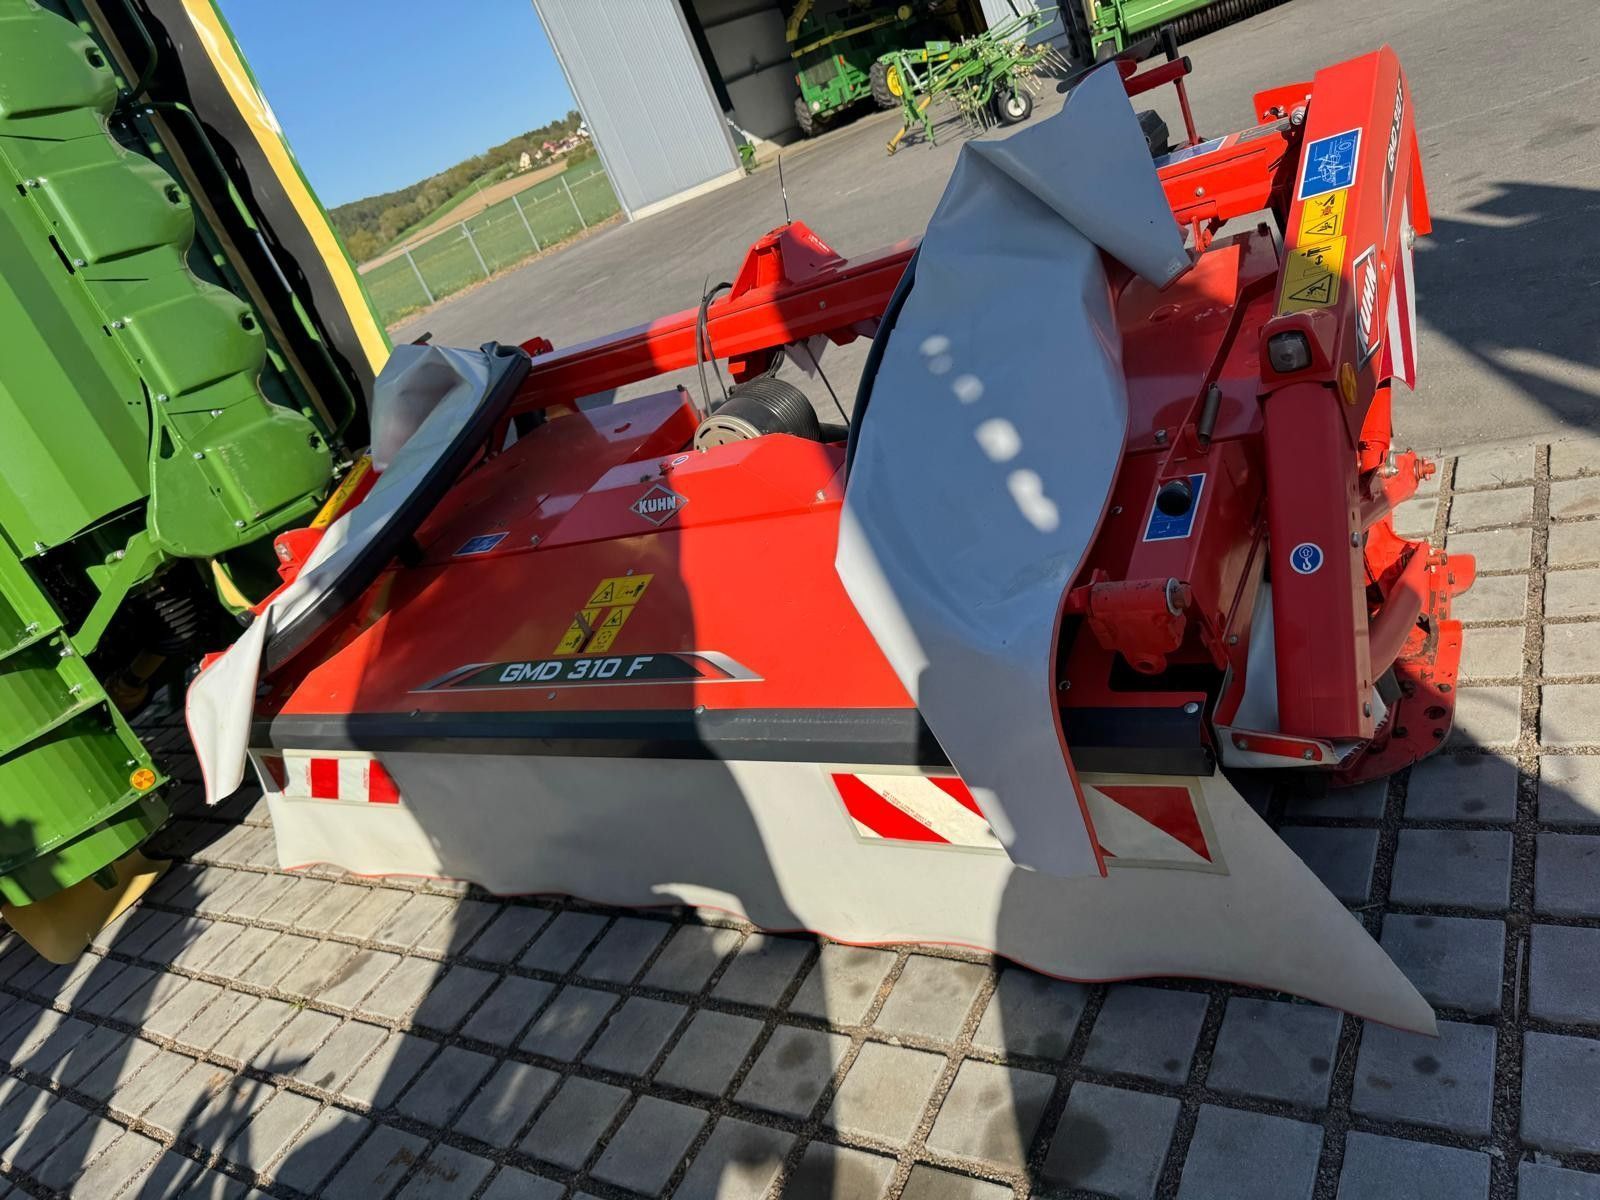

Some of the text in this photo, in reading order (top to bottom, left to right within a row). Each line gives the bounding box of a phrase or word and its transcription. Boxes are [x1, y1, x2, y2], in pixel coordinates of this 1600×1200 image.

[1357, 254, 1377, 356] KUHN
[639, 495, 676, 514] KUHN
[499, 656, 654, 682] GMD 310 F
